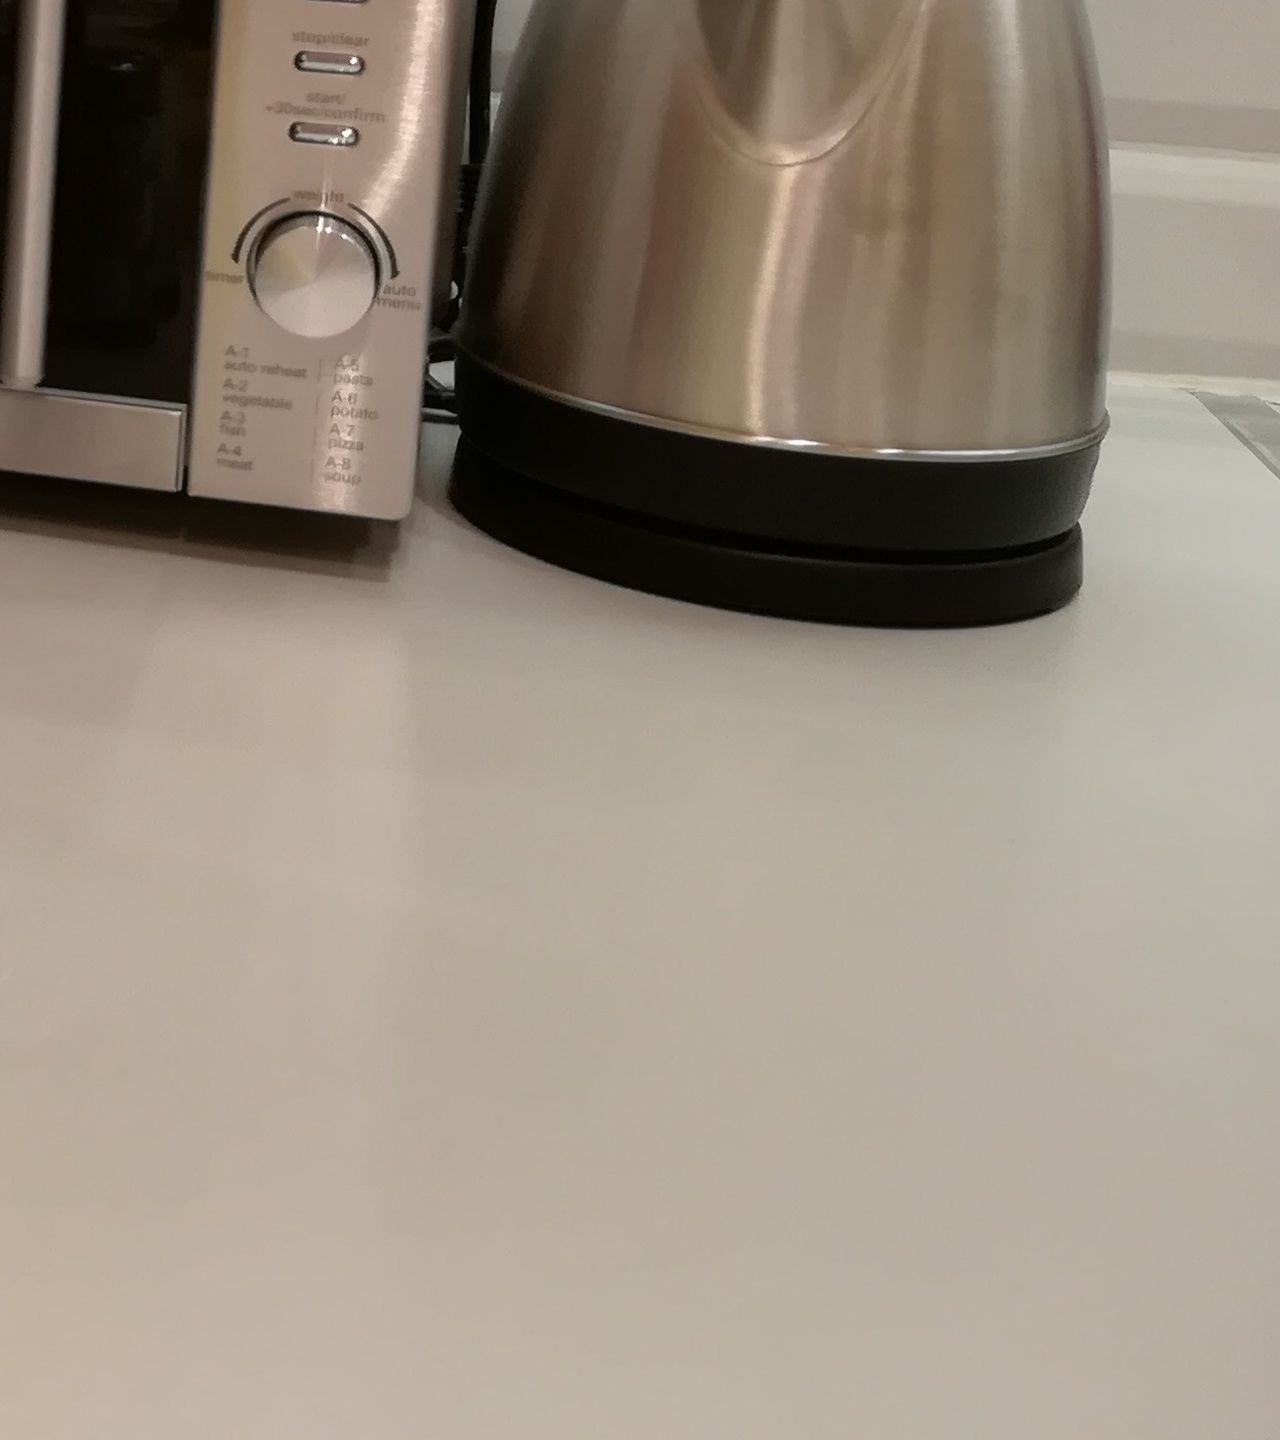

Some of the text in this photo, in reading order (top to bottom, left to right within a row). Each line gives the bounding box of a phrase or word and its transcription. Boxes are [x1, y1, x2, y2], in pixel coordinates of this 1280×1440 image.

[382, 283, 417, 297] auto
[329, 406, 380, 420] potato
[327, 437, 365, 452] pizza
[324, 471, 362, 487] soup
